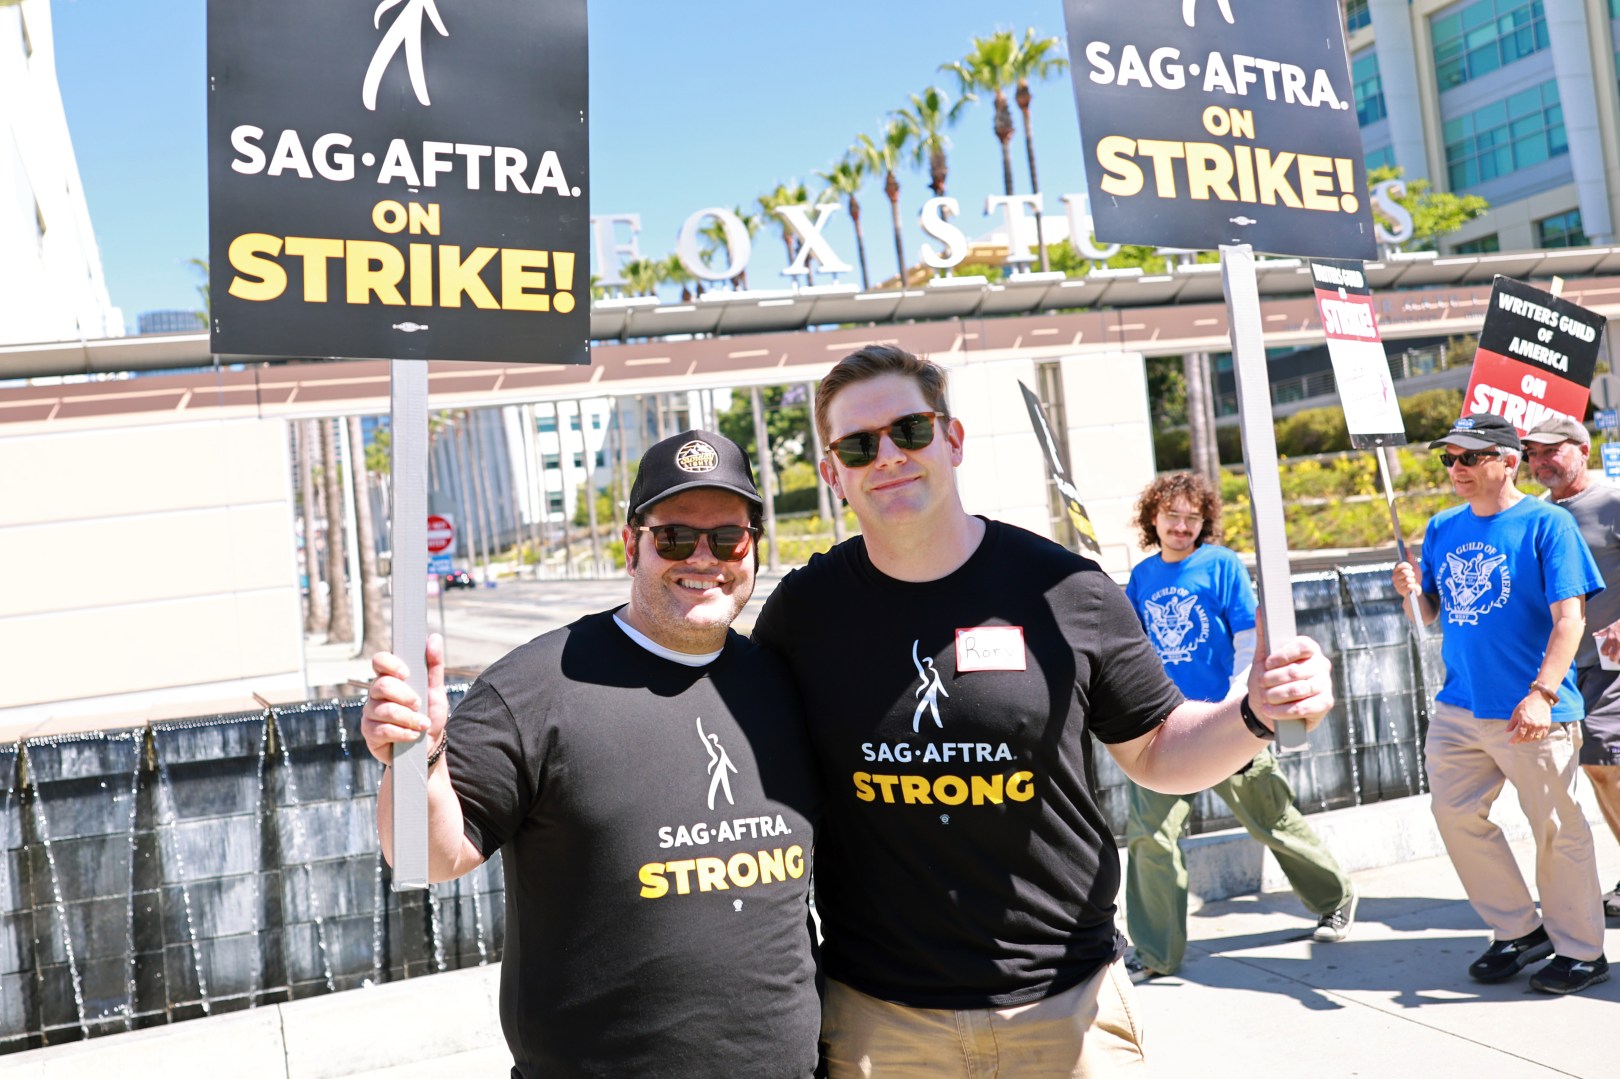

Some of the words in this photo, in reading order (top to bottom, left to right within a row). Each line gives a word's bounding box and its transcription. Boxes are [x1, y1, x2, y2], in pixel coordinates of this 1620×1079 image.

[1202, 106, 1255, 140] ON
[1096, 135, 1360, 215] STRIKE!
[372, 199, 440, 236] ON
[590, 201, 852, 287] FOX
[227, 232, 576, 315] STRIKE!
[1498, 292, 1559, 328] WRITERS
[1559, 315, 1596, 343] GUILD
[1537, 327, 1554, 344] OF
[1508, 336, 1569, 372] AMERICA
[1520, 374, 1548, 400] ON
[1455, 541, 1484, 555] GUILD
[1484, 544, 1498, 555] OF
[1151, 586, 1177, 601] GUILD
[1493, 565, 1511, 608] AMERICA
[852, 771, 1035, 806] STRONG
[638, 845, 805, 899] STRONG
